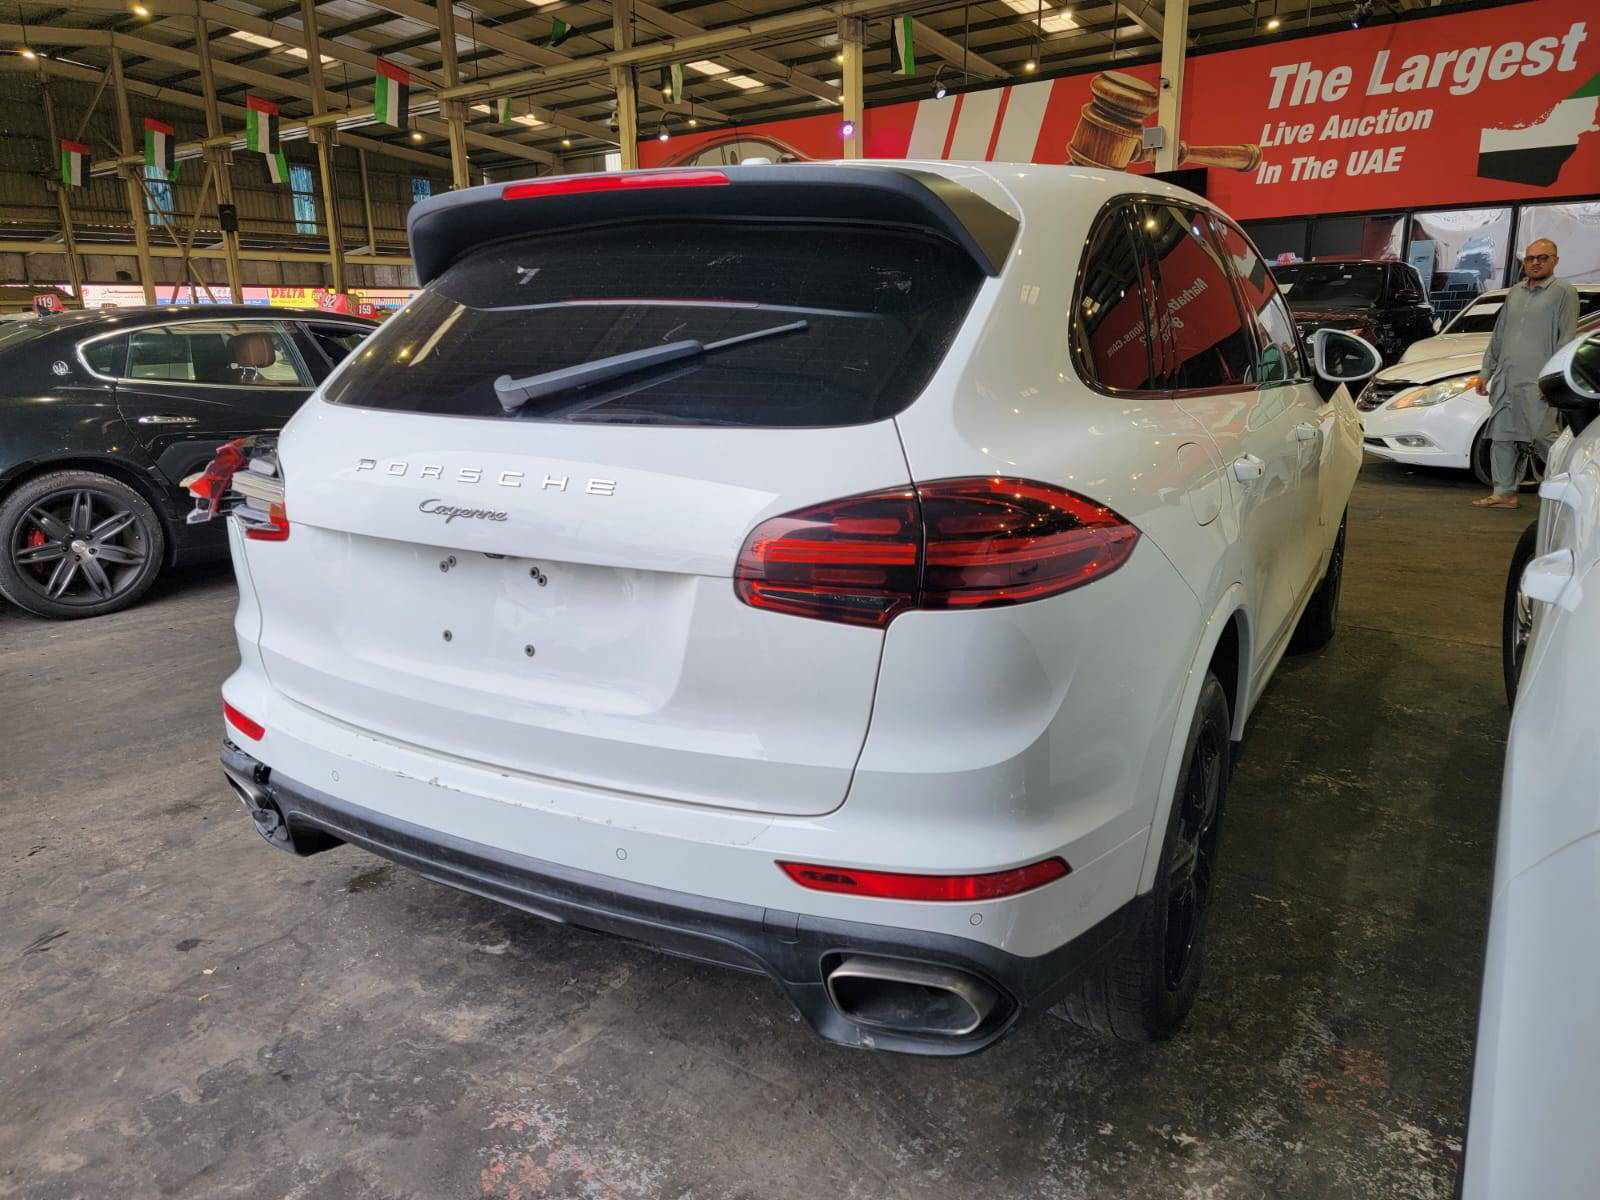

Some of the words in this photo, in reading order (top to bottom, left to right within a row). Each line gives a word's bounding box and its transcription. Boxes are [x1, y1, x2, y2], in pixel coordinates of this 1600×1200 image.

[1268, 61, 1353, 109] The
[1365, 21, 1588, 96] Largest
[1258, 120, 1314, 148] Live
[1318, 106, 1435, 142] Auction
[1255, 160, 1282, 185] In
[1290, 154, 1339, 182] The
[1345, 145, 1406, 177] UAE
[271, 287, 306, 299] DELTA
[322, 294, 337, 308] 92
[355, 457, 617, 496] PORSCHE
[418, 497, 508, 524] Cayenne
